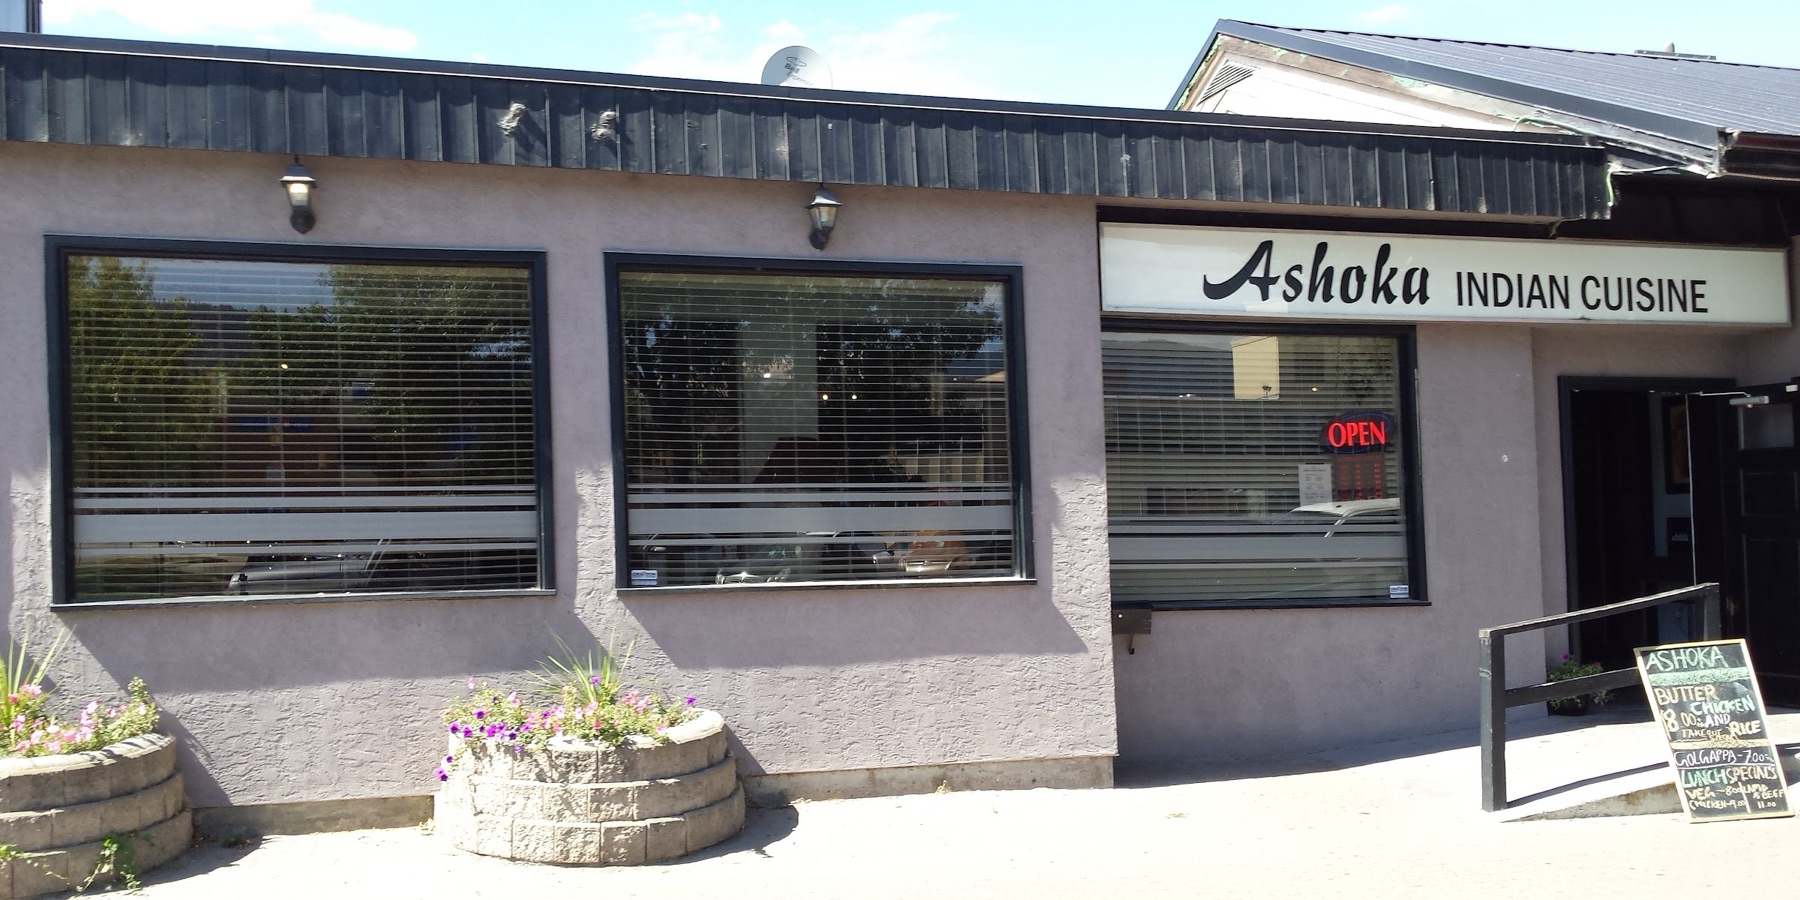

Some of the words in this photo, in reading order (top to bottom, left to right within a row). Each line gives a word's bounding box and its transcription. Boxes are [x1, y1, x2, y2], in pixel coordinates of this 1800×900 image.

[1203, 240, 1431, 305] Ashoka
[1456, 271, 1570, 309] INDIAN
[1580, 275, 1709, 313] CUISINE
[1327, 421, 1387, 448] OPEN
[1645, 645, 1730, 672] ASHOKA
[1653, 684, 1720, 706] BUTTER
[1689, 694, 1756, 716] CHICKEN
[1705, 713, 1731, 728] AND
[1727, 720, 1762, 737] RICE
[1681, 768, 1728, 788] LUNCH
[1685, 786, 1716, 800] VEG
